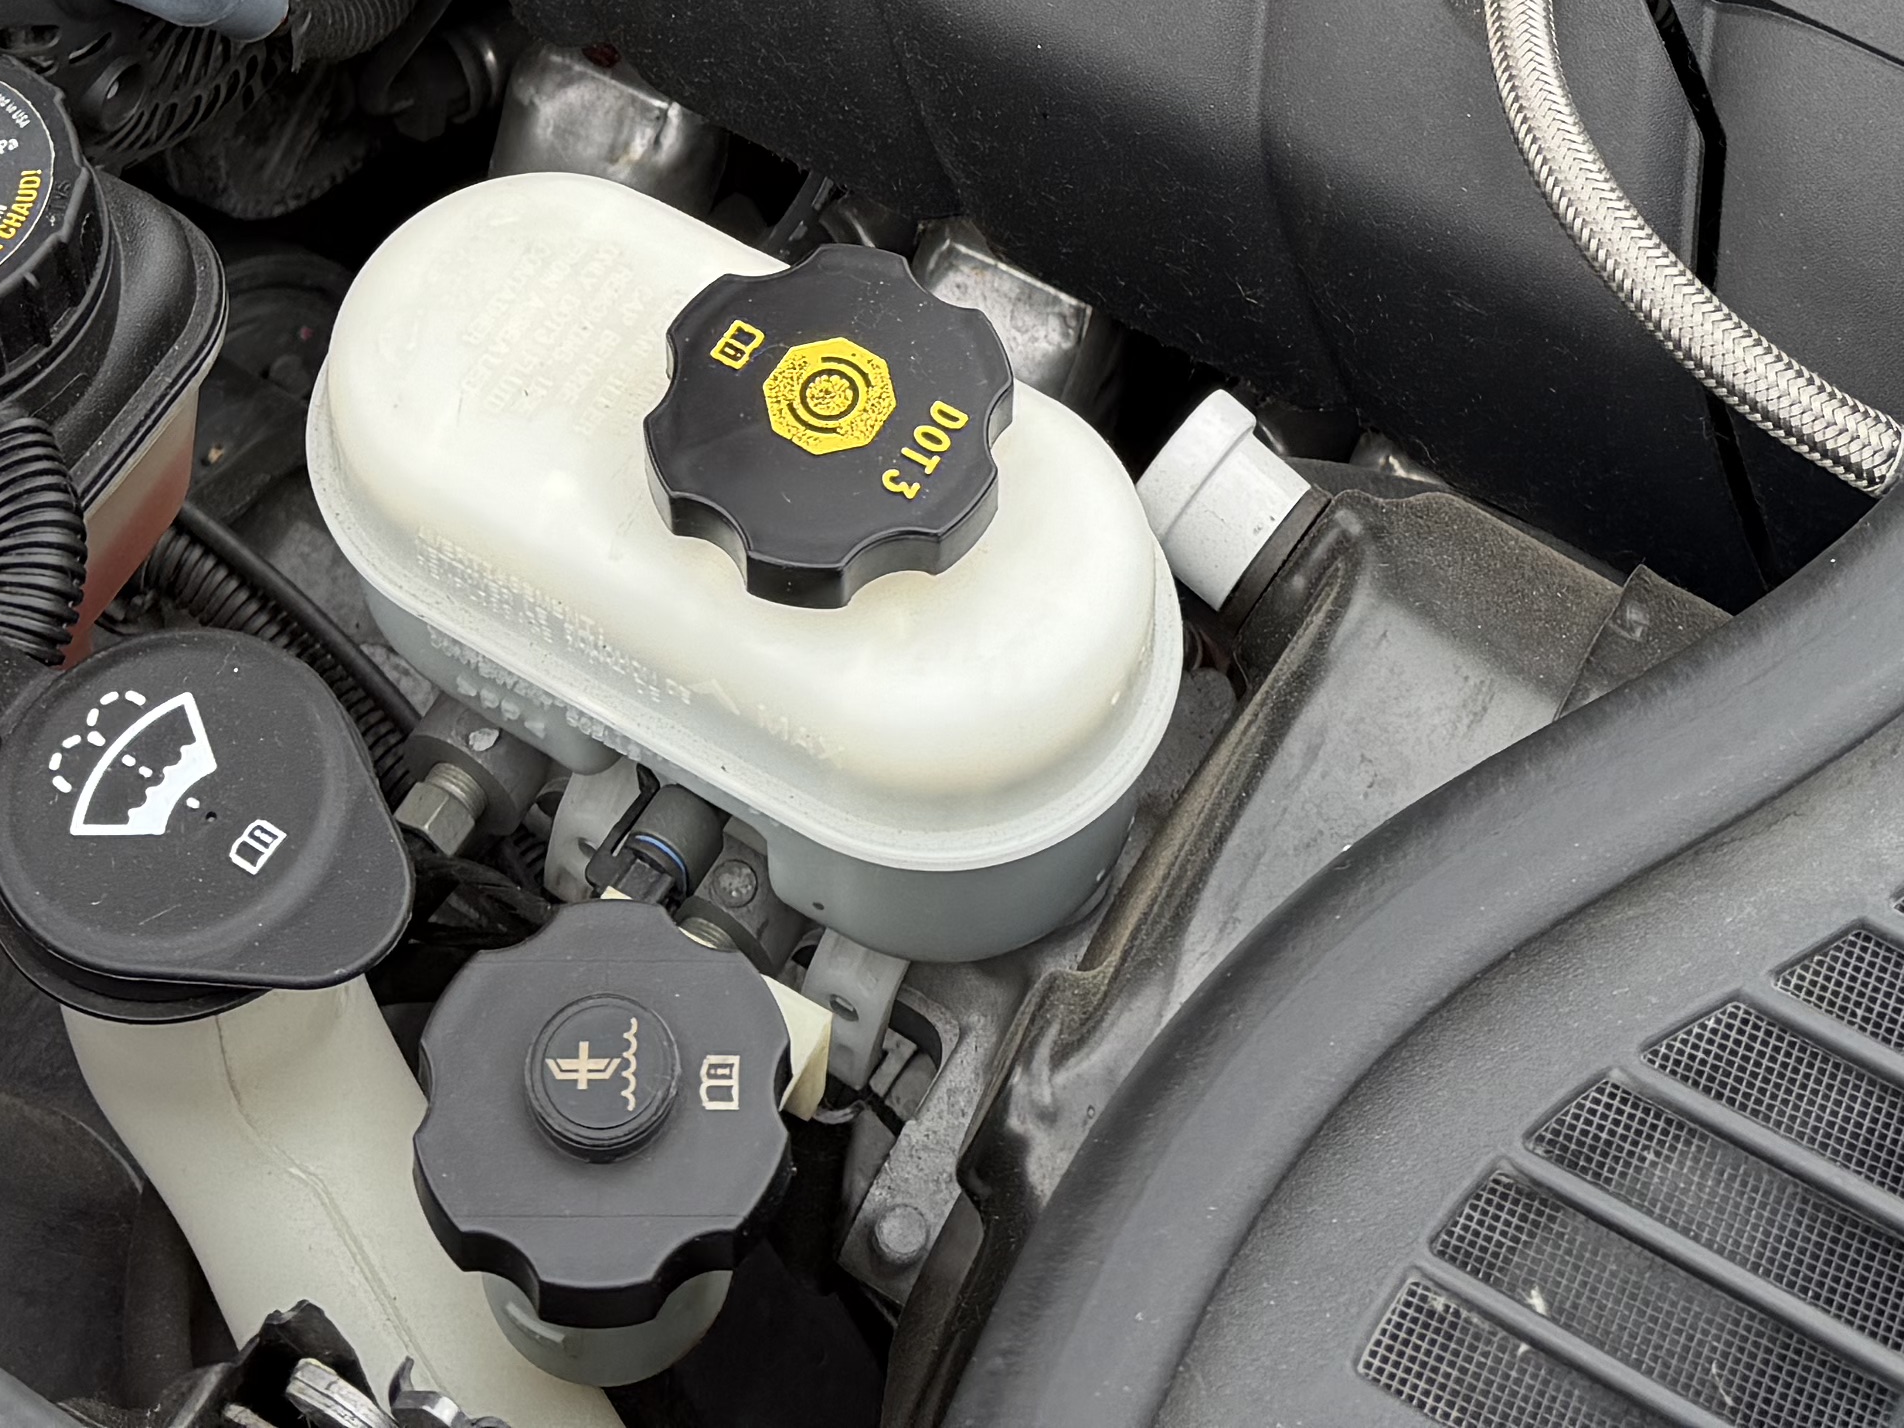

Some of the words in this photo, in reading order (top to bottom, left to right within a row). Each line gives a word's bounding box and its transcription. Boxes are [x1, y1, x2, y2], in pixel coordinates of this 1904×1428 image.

[11, 107, 31, 129] USA
[901, 400, 969, 475] DOT
[881, 468, 922, 500] 3
